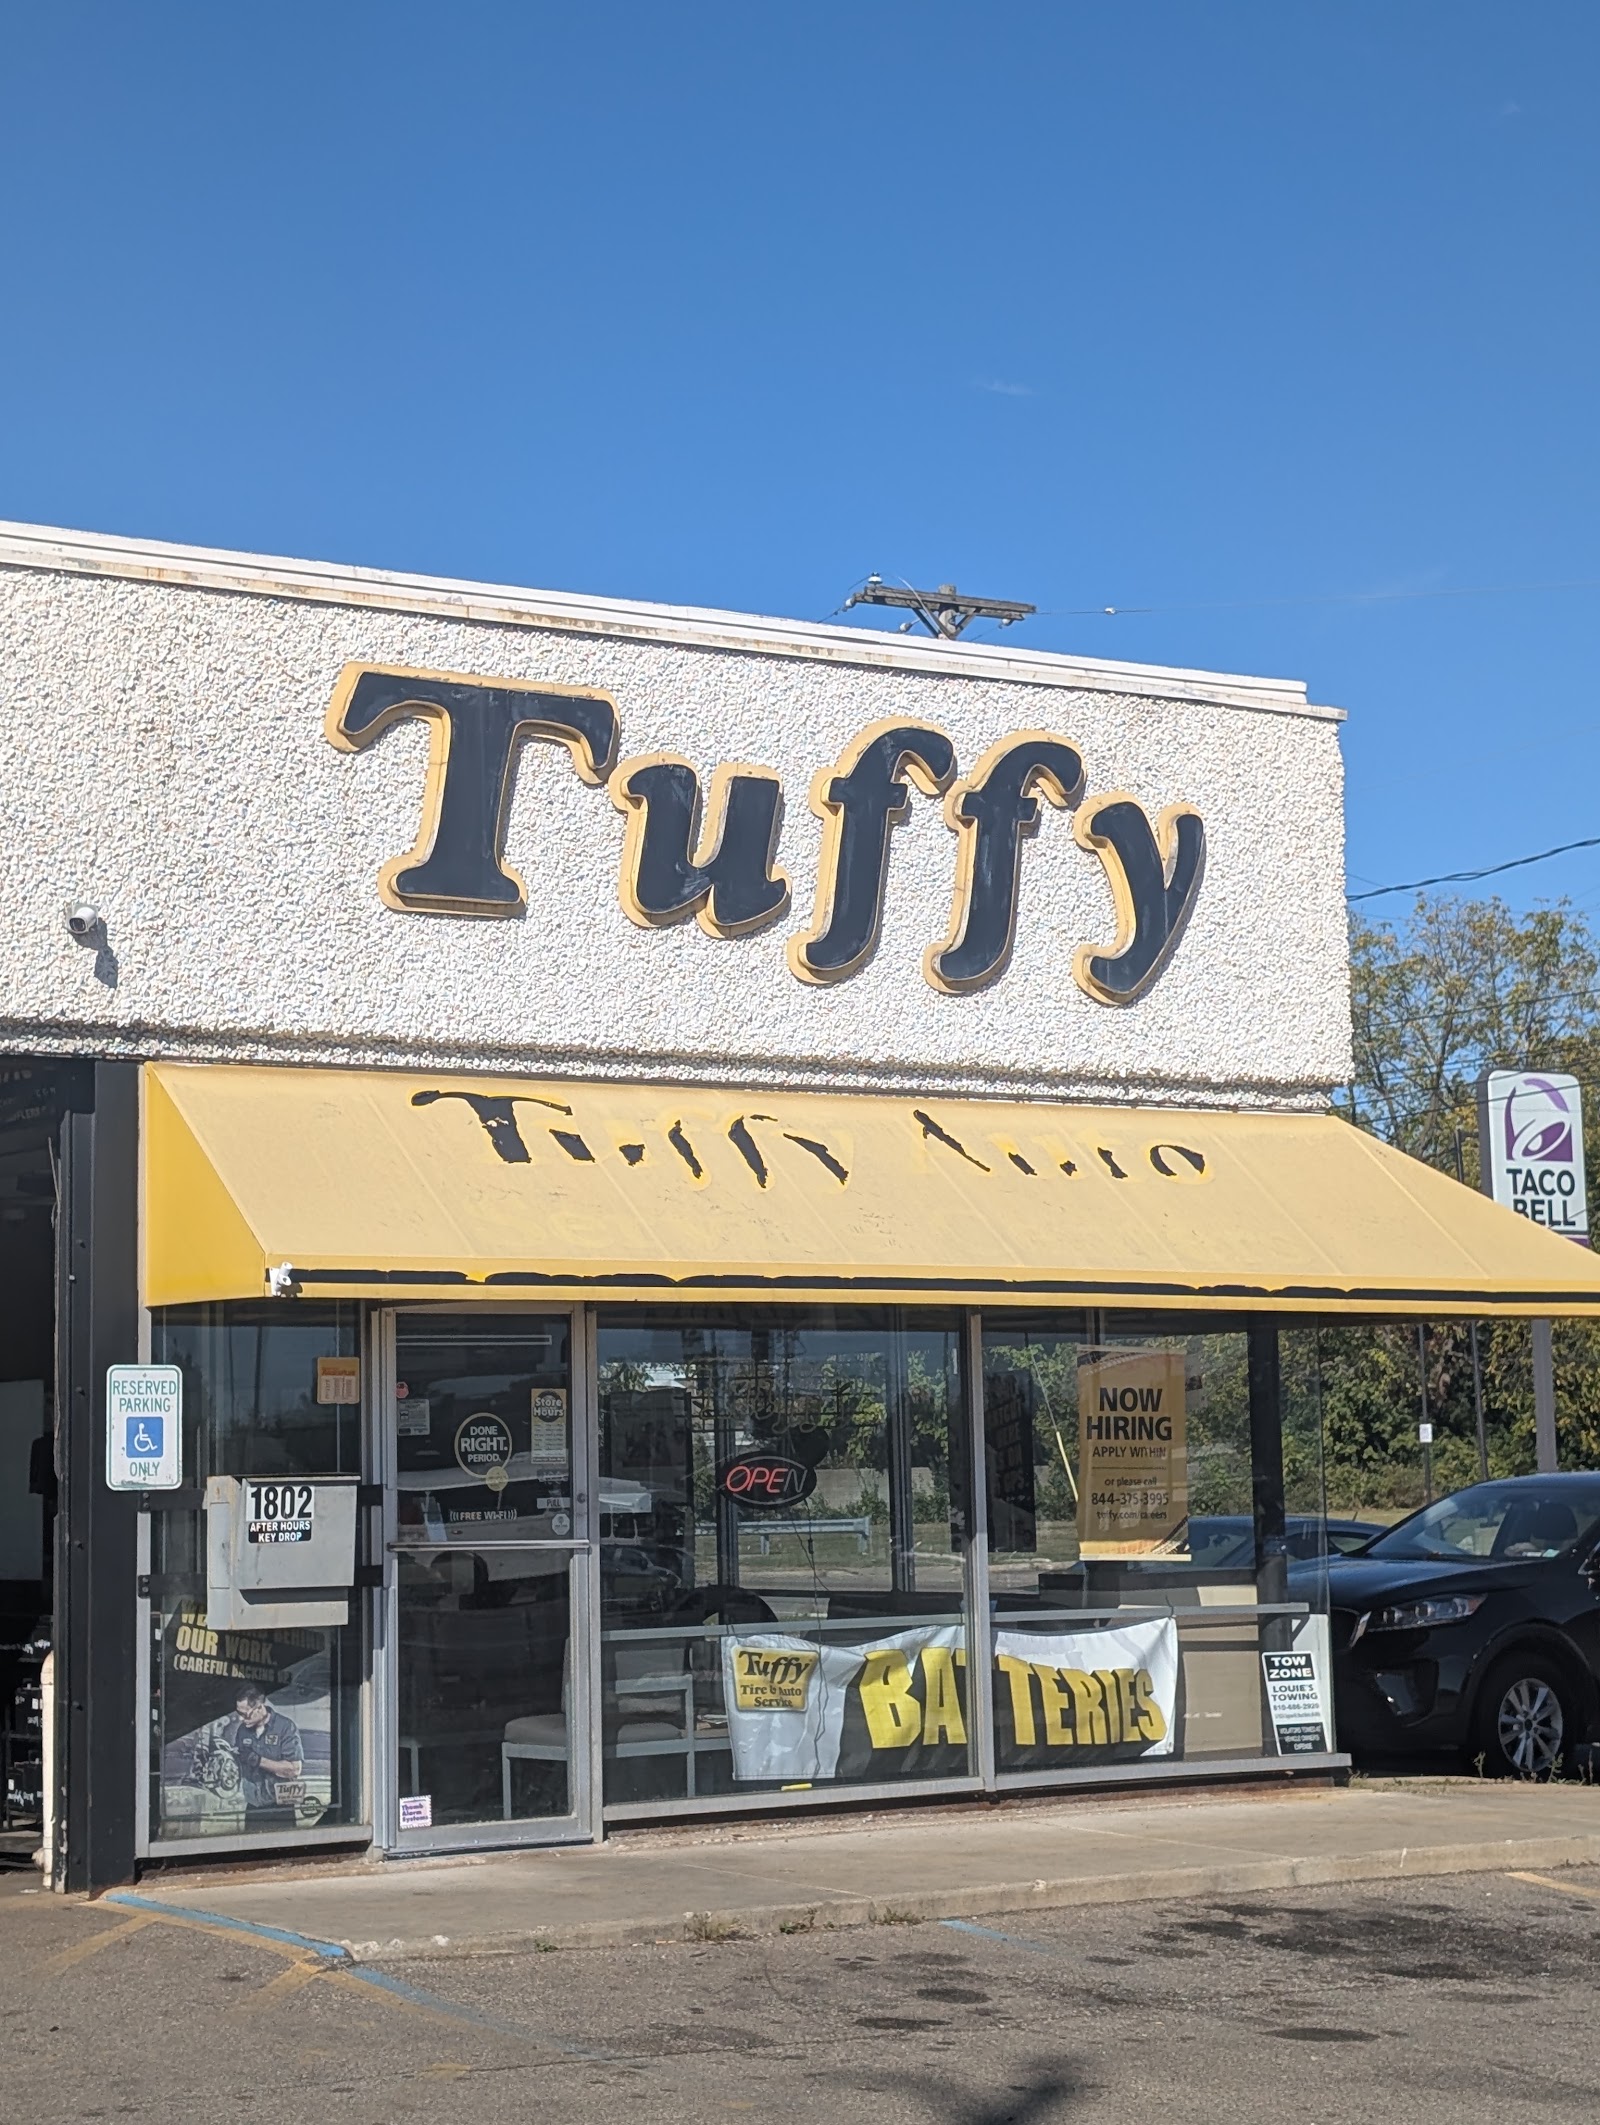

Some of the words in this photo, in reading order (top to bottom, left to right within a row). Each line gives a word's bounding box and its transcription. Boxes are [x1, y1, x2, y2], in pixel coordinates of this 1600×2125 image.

[323, 661, 1203, 1006] Tuffy
[1506, 1168, 1575, 1197] TACO
[1513, 1199, 1576, 1226] BELL
[112, 1380, 177, 1396] RESERVED
[119, 1397, 171, 1413] PARKING
[535, 1397, 562, 1407] Store
[1099, 1387, 1162, 1412] NOW
[533, 1407, 564, 1418] Hours
[470, 1426, 498, 1436] DONE
[1086, 1416, 1172, 1441] HIRING
[460, 1437, 509, 1453] RIGHT.
[1092, 1446, 1127, 1458] APPLY
[1130, 1446, 1167, 1458] WITHIN
[129, 1462, 160, 1477] ONLY
[726, 1465, 808, 1493] OPEN
[1117, 1477, 1142, 1487] please
[1143, 1476, 1157, 1486] call
[250, 1485, 312, 1520] 1802
[1091, 1493, 1169, 1505] 844-375-3995
[460, 1511, 482, 1521] FREE
[1097, 1510, 1168, 1522] tufy.com/caeers
[250, 1522, 279, 1533] AFTER
[280, 1521, 311, 1531] HOURS
[258, 1532, 277, 1543] KEY
[278, 1531, 302, 1542] DROP
[176, 1626, 219, 1656] OUR
[224, 1634, 278, 1666] WORK.
[173, 1653, 229, 1677] (CAREFUL
[231, 1664, 275, 1682] BACKING
[1270, 1656, 1306, 1667] TOW
[738, 1651, 812, 1685] Tuffy
[1269, 1668, 1312, 1679] ZONE
[740, 1685, 768, 1695] Tire
[779, 1686, 803, 1696] Auto
[1272, 1684, 1314, 1693] LOUIE'S
[753, 1697, 794, 1708] Service
[859, 1647, 1167, 1749] BATERIES
[1271, 1693, 1318, 1702] TOWING
[276, 1784, 303, 1796] Tuffy
